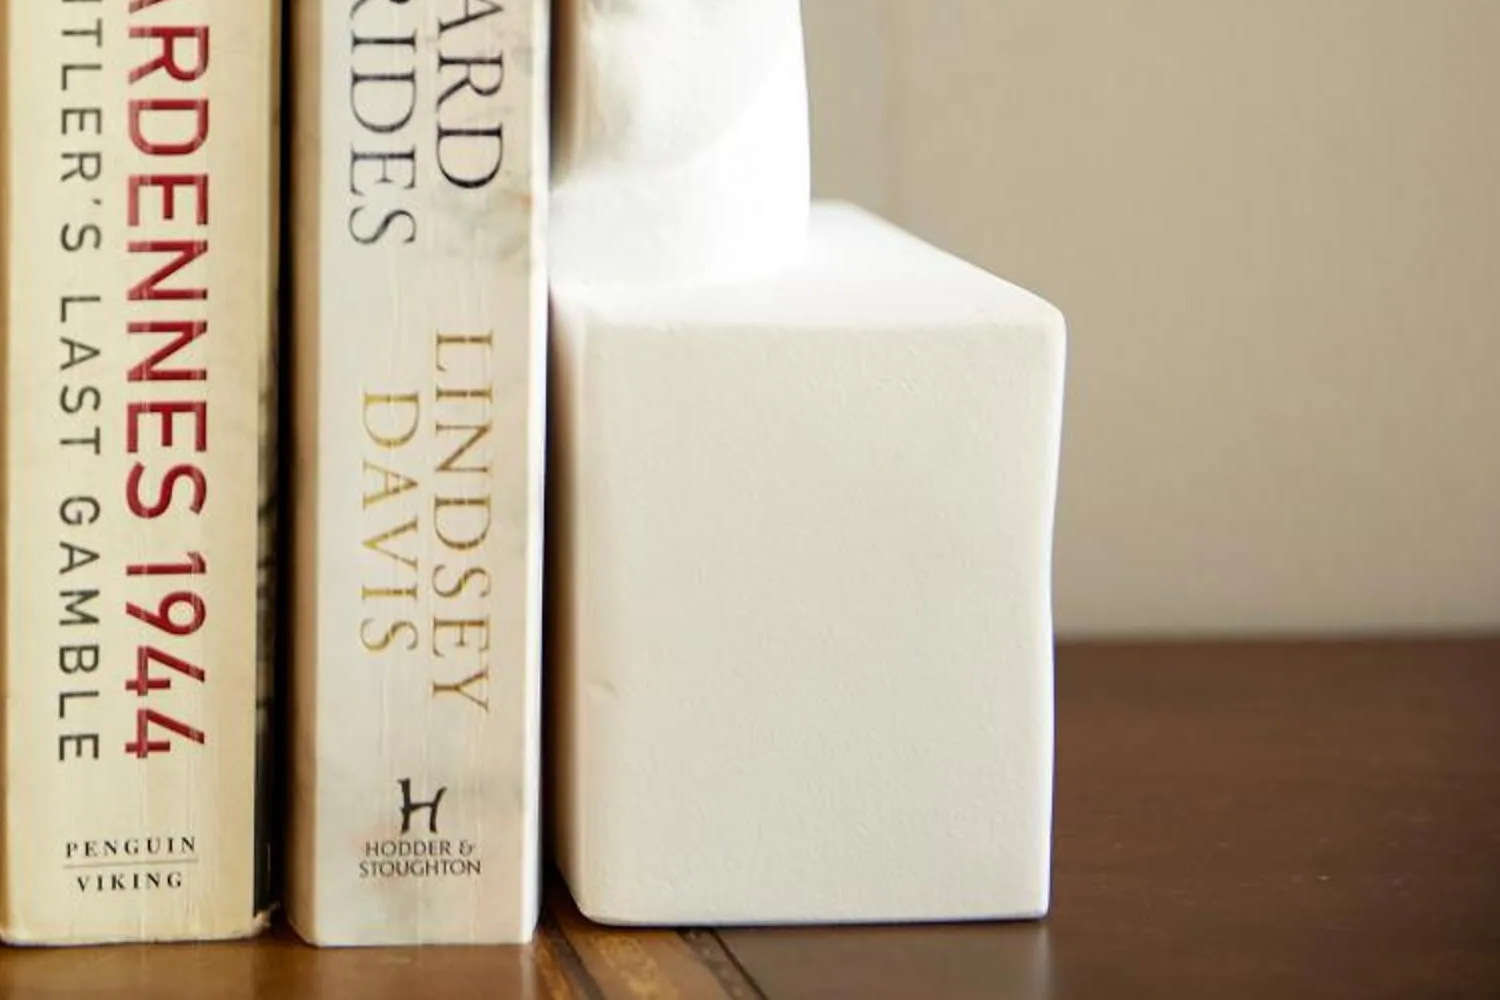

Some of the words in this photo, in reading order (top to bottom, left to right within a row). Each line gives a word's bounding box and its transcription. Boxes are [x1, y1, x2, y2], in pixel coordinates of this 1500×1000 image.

[58, 296, 102, 455] LAST
[360, 391, 420, 653] DAVIS
[431, 329, 494, 713] LINDSEY
[58, 495, 100, 762] GAMBLE
[125, 551, 206, 760] 1944
[65, 836, 196, 859] PENGUIN
[76, 872, 182, 892] VIKING
[359, 860, 481, 878] STOUGHTON
[365, 841, 453, 858] HODDER
[459, 841, 476, 857] &
